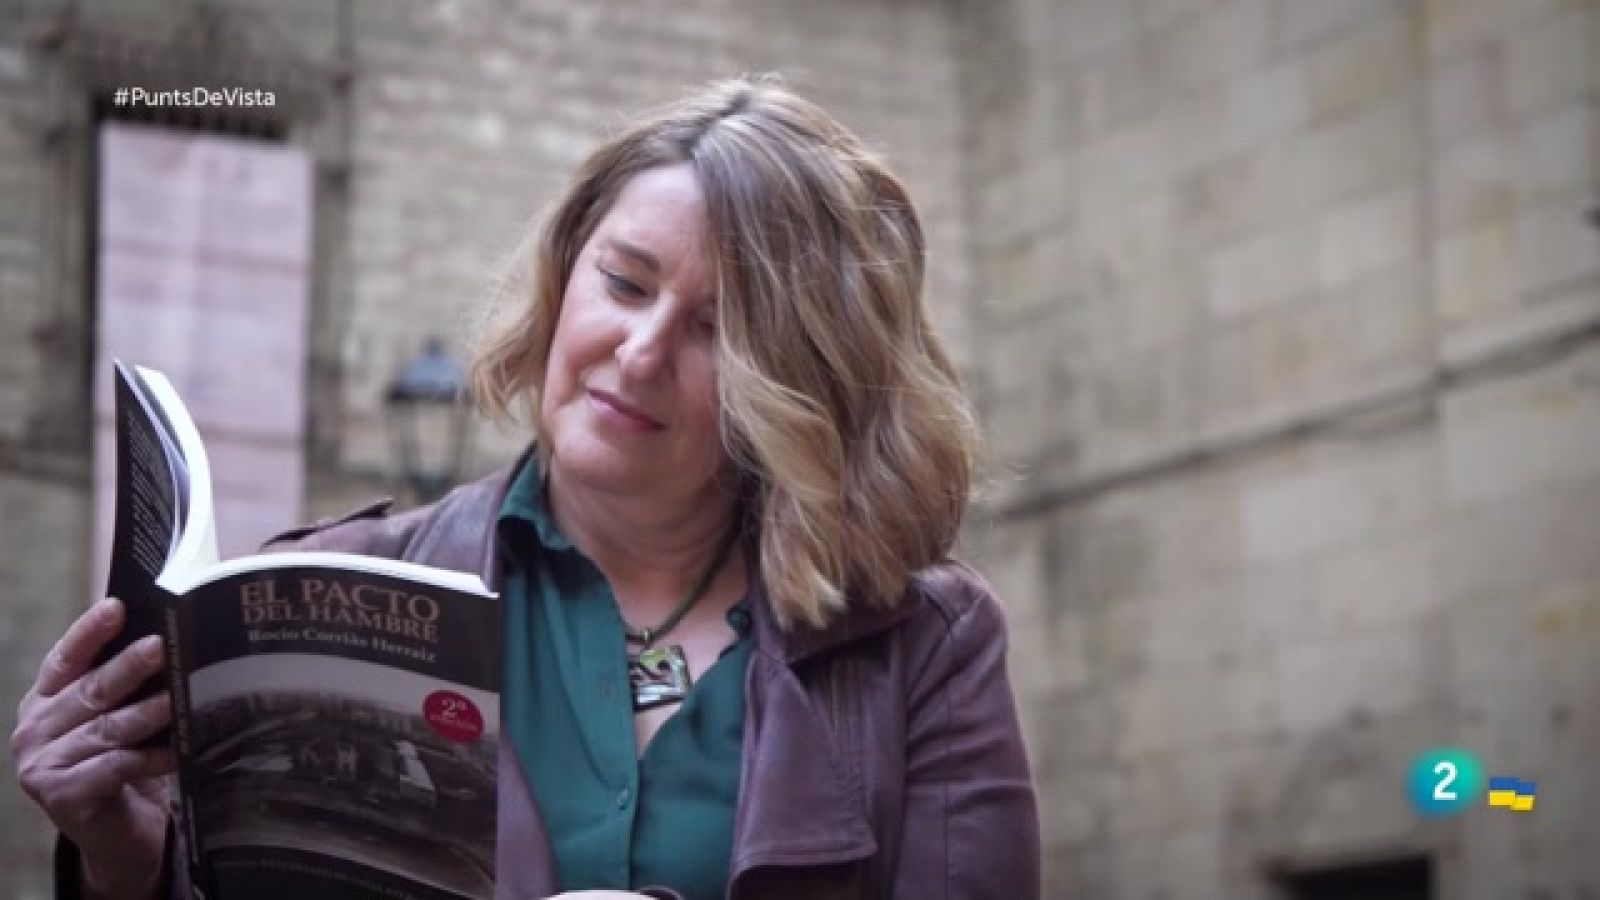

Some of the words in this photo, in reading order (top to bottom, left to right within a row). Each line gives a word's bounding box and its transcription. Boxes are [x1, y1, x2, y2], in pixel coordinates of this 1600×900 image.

[240, 579, 289, 606] EL
[302, 579, 440, 622] PACTO
[243, 604, 300, 625] DEL
[309, 604, 438, 641] HAMBRE
